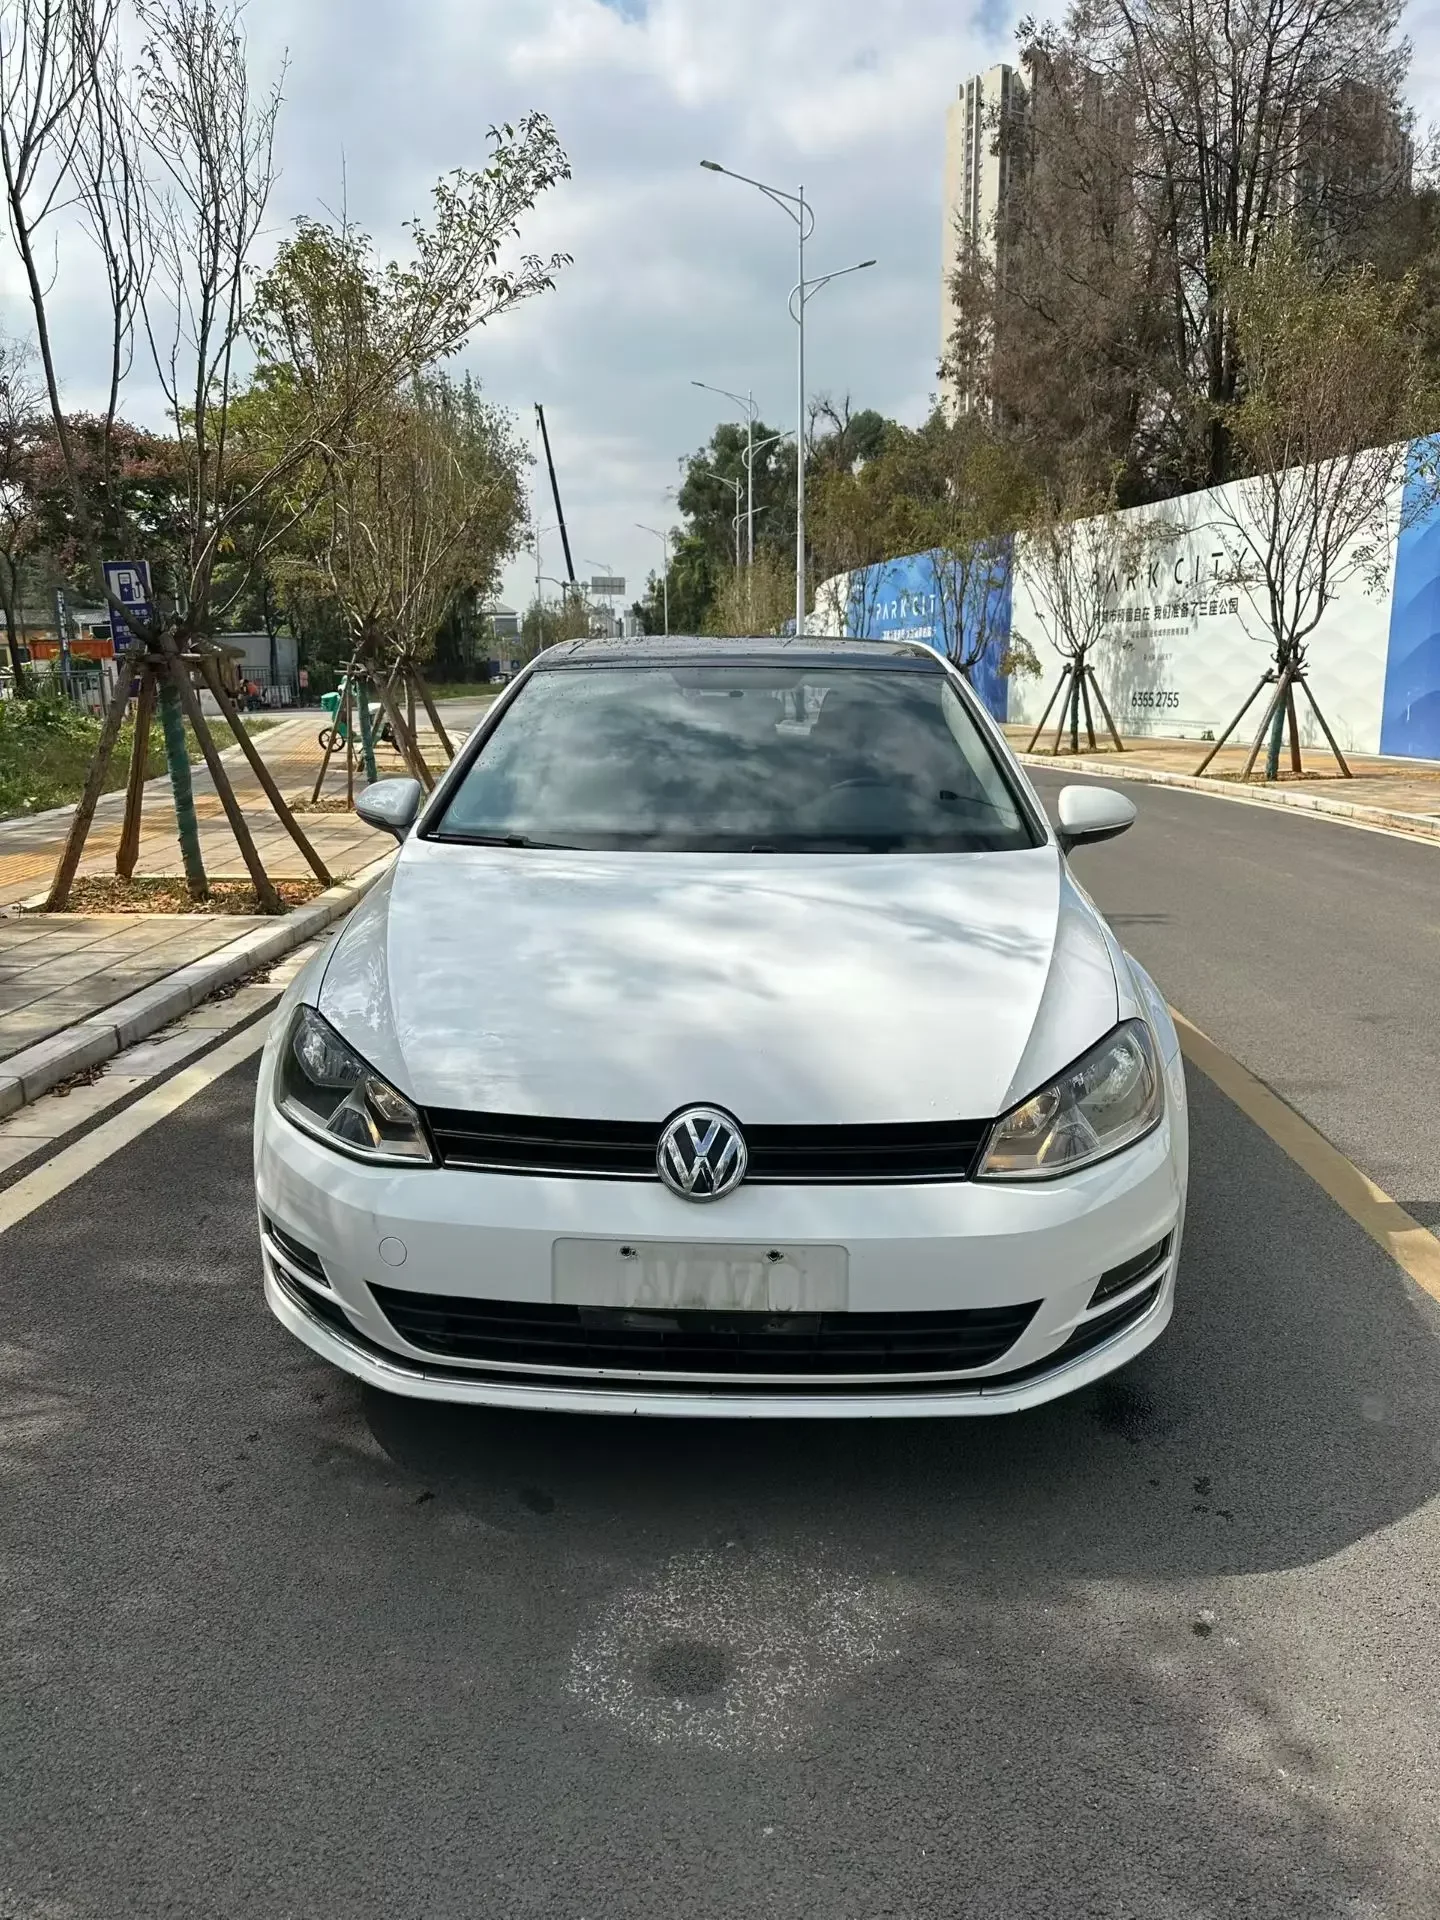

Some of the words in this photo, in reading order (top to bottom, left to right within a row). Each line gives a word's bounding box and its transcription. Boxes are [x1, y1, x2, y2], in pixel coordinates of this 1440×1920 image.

[876, 597, 907, 620] PARK
[912, 592, 948, 616] CIT
[1155, 691, 1180, 708] 2755
